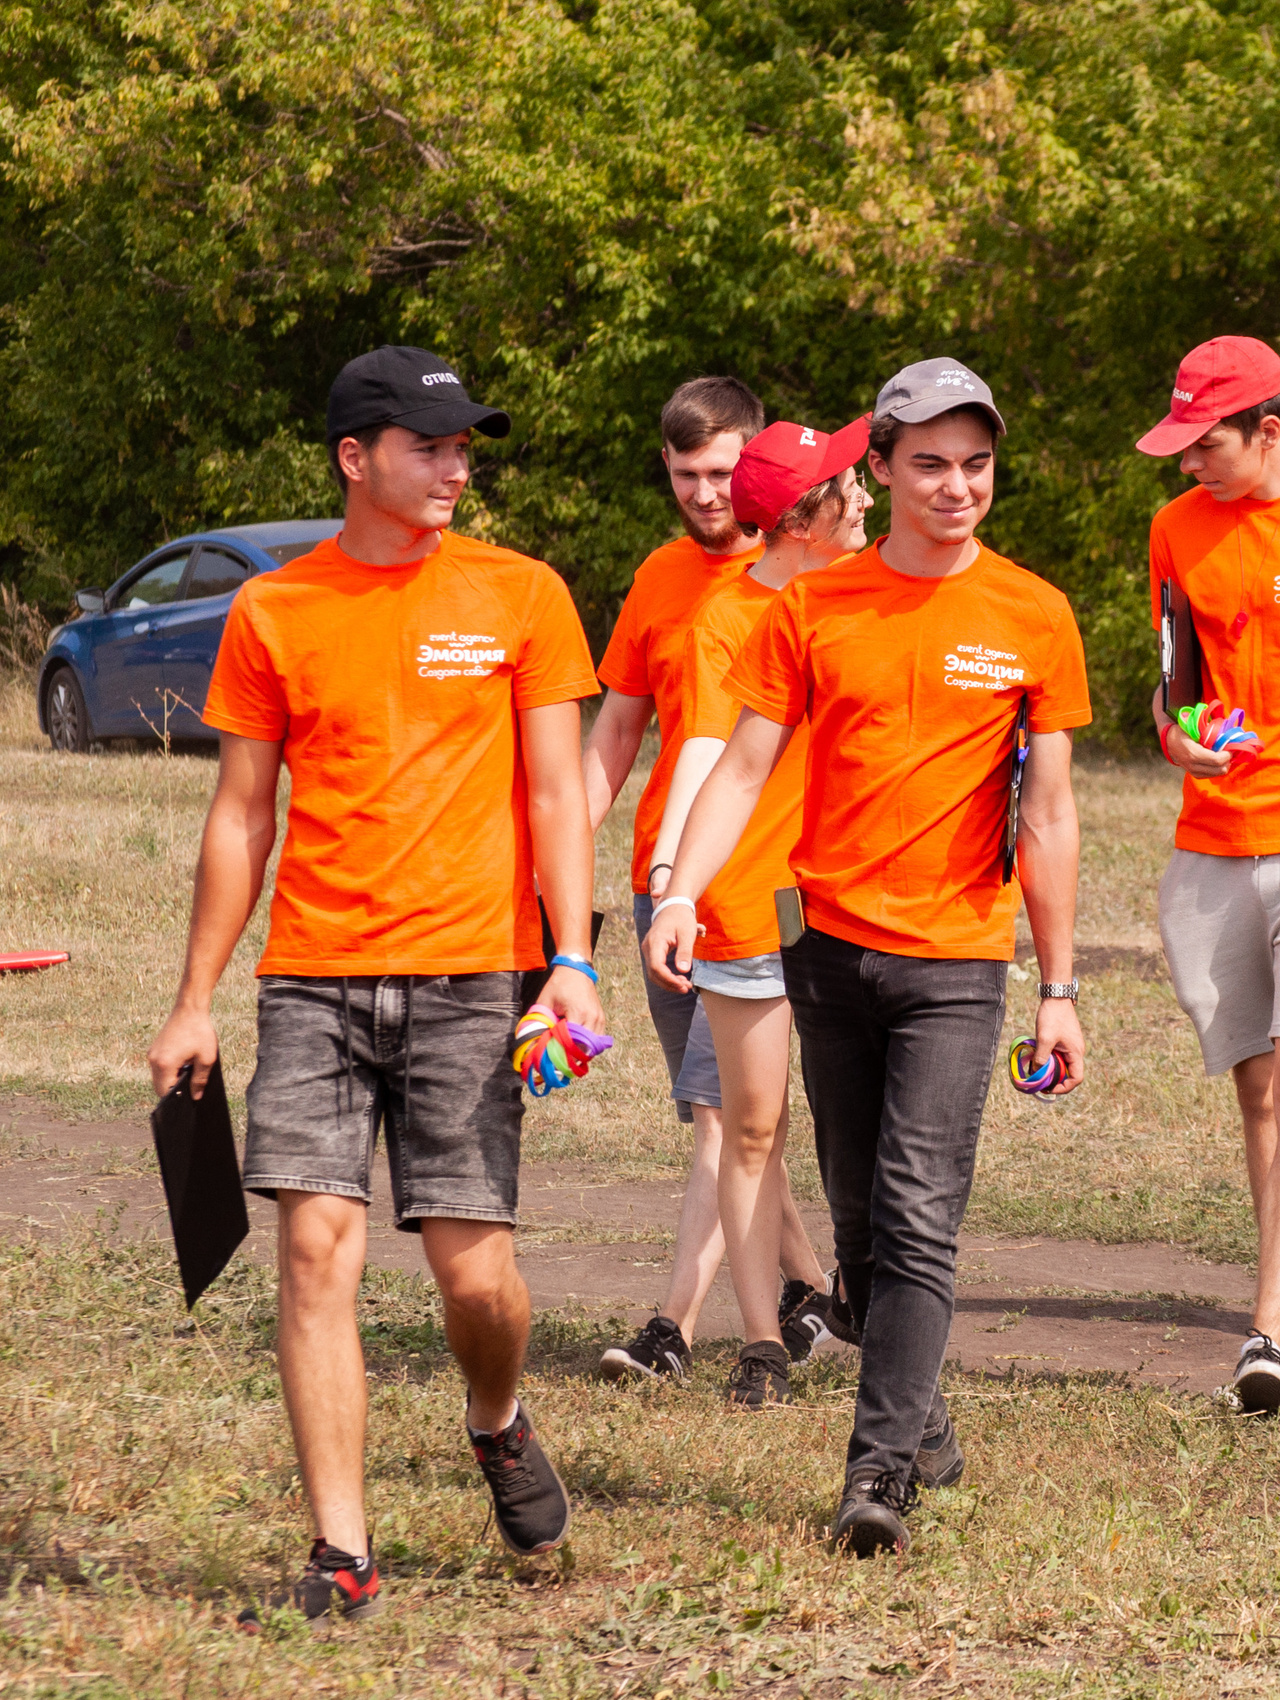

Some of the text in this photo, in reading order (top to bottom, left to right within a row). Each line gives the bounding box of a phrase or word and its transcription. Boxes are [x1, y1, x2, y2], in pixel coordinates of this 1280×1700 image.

[429, 631, 496, 646] event agency
[416, 644, 506, 664] Эмоция
[956, 643, 1017, 661] event agency
[944, 653, 1025, 681] Эмоция
